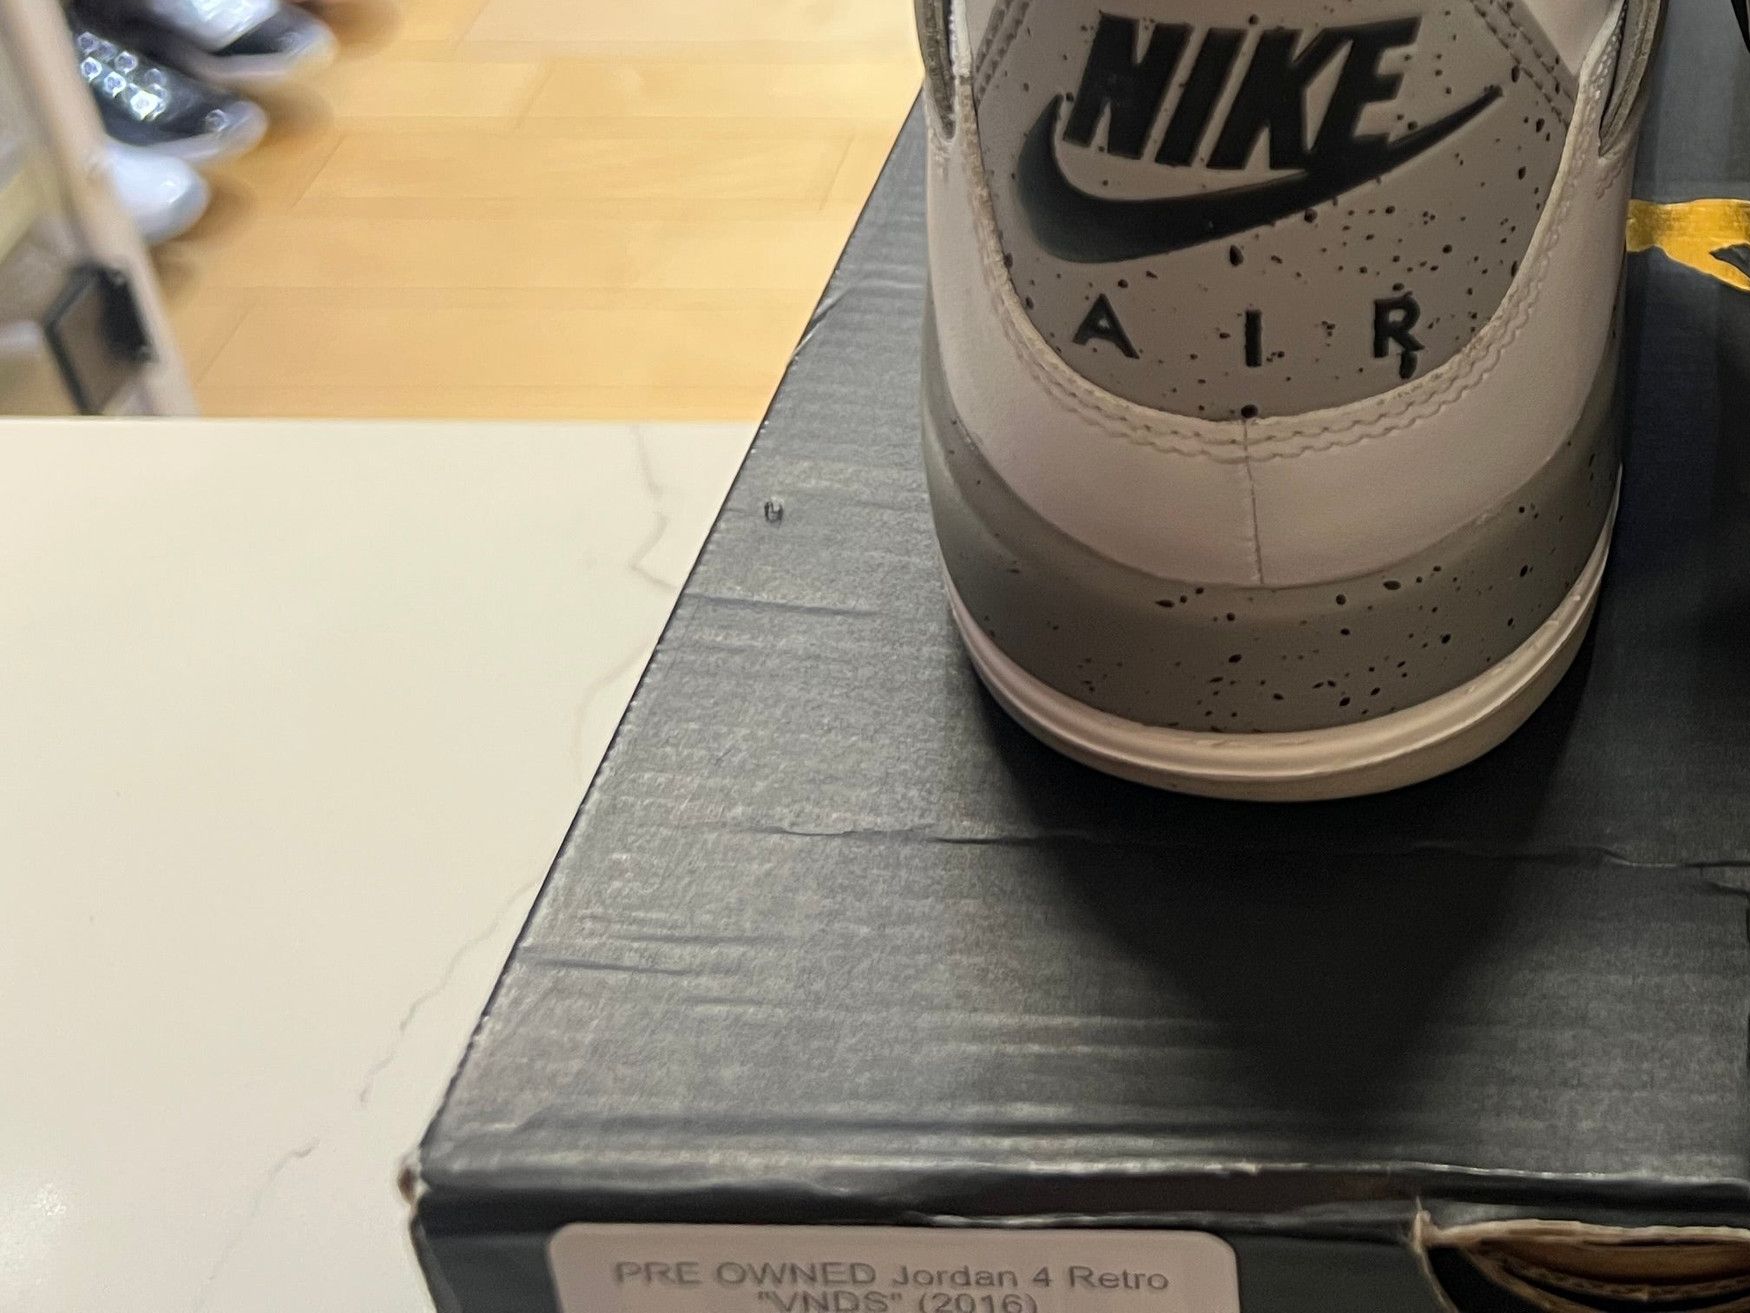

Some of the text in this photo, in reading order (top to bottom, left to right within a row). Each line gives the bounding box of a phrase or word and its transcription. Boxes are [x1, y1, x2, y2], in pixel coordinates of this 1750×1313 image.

[1061, 10, 1424, 171] NIKE
[1072, 293, 1426, 369] AIR
[614, 1260, 1169, 1290] PRE OWNED Jordan 4 Retro
[757, 1289, 1038, 1313] "VNDS" (2016)
